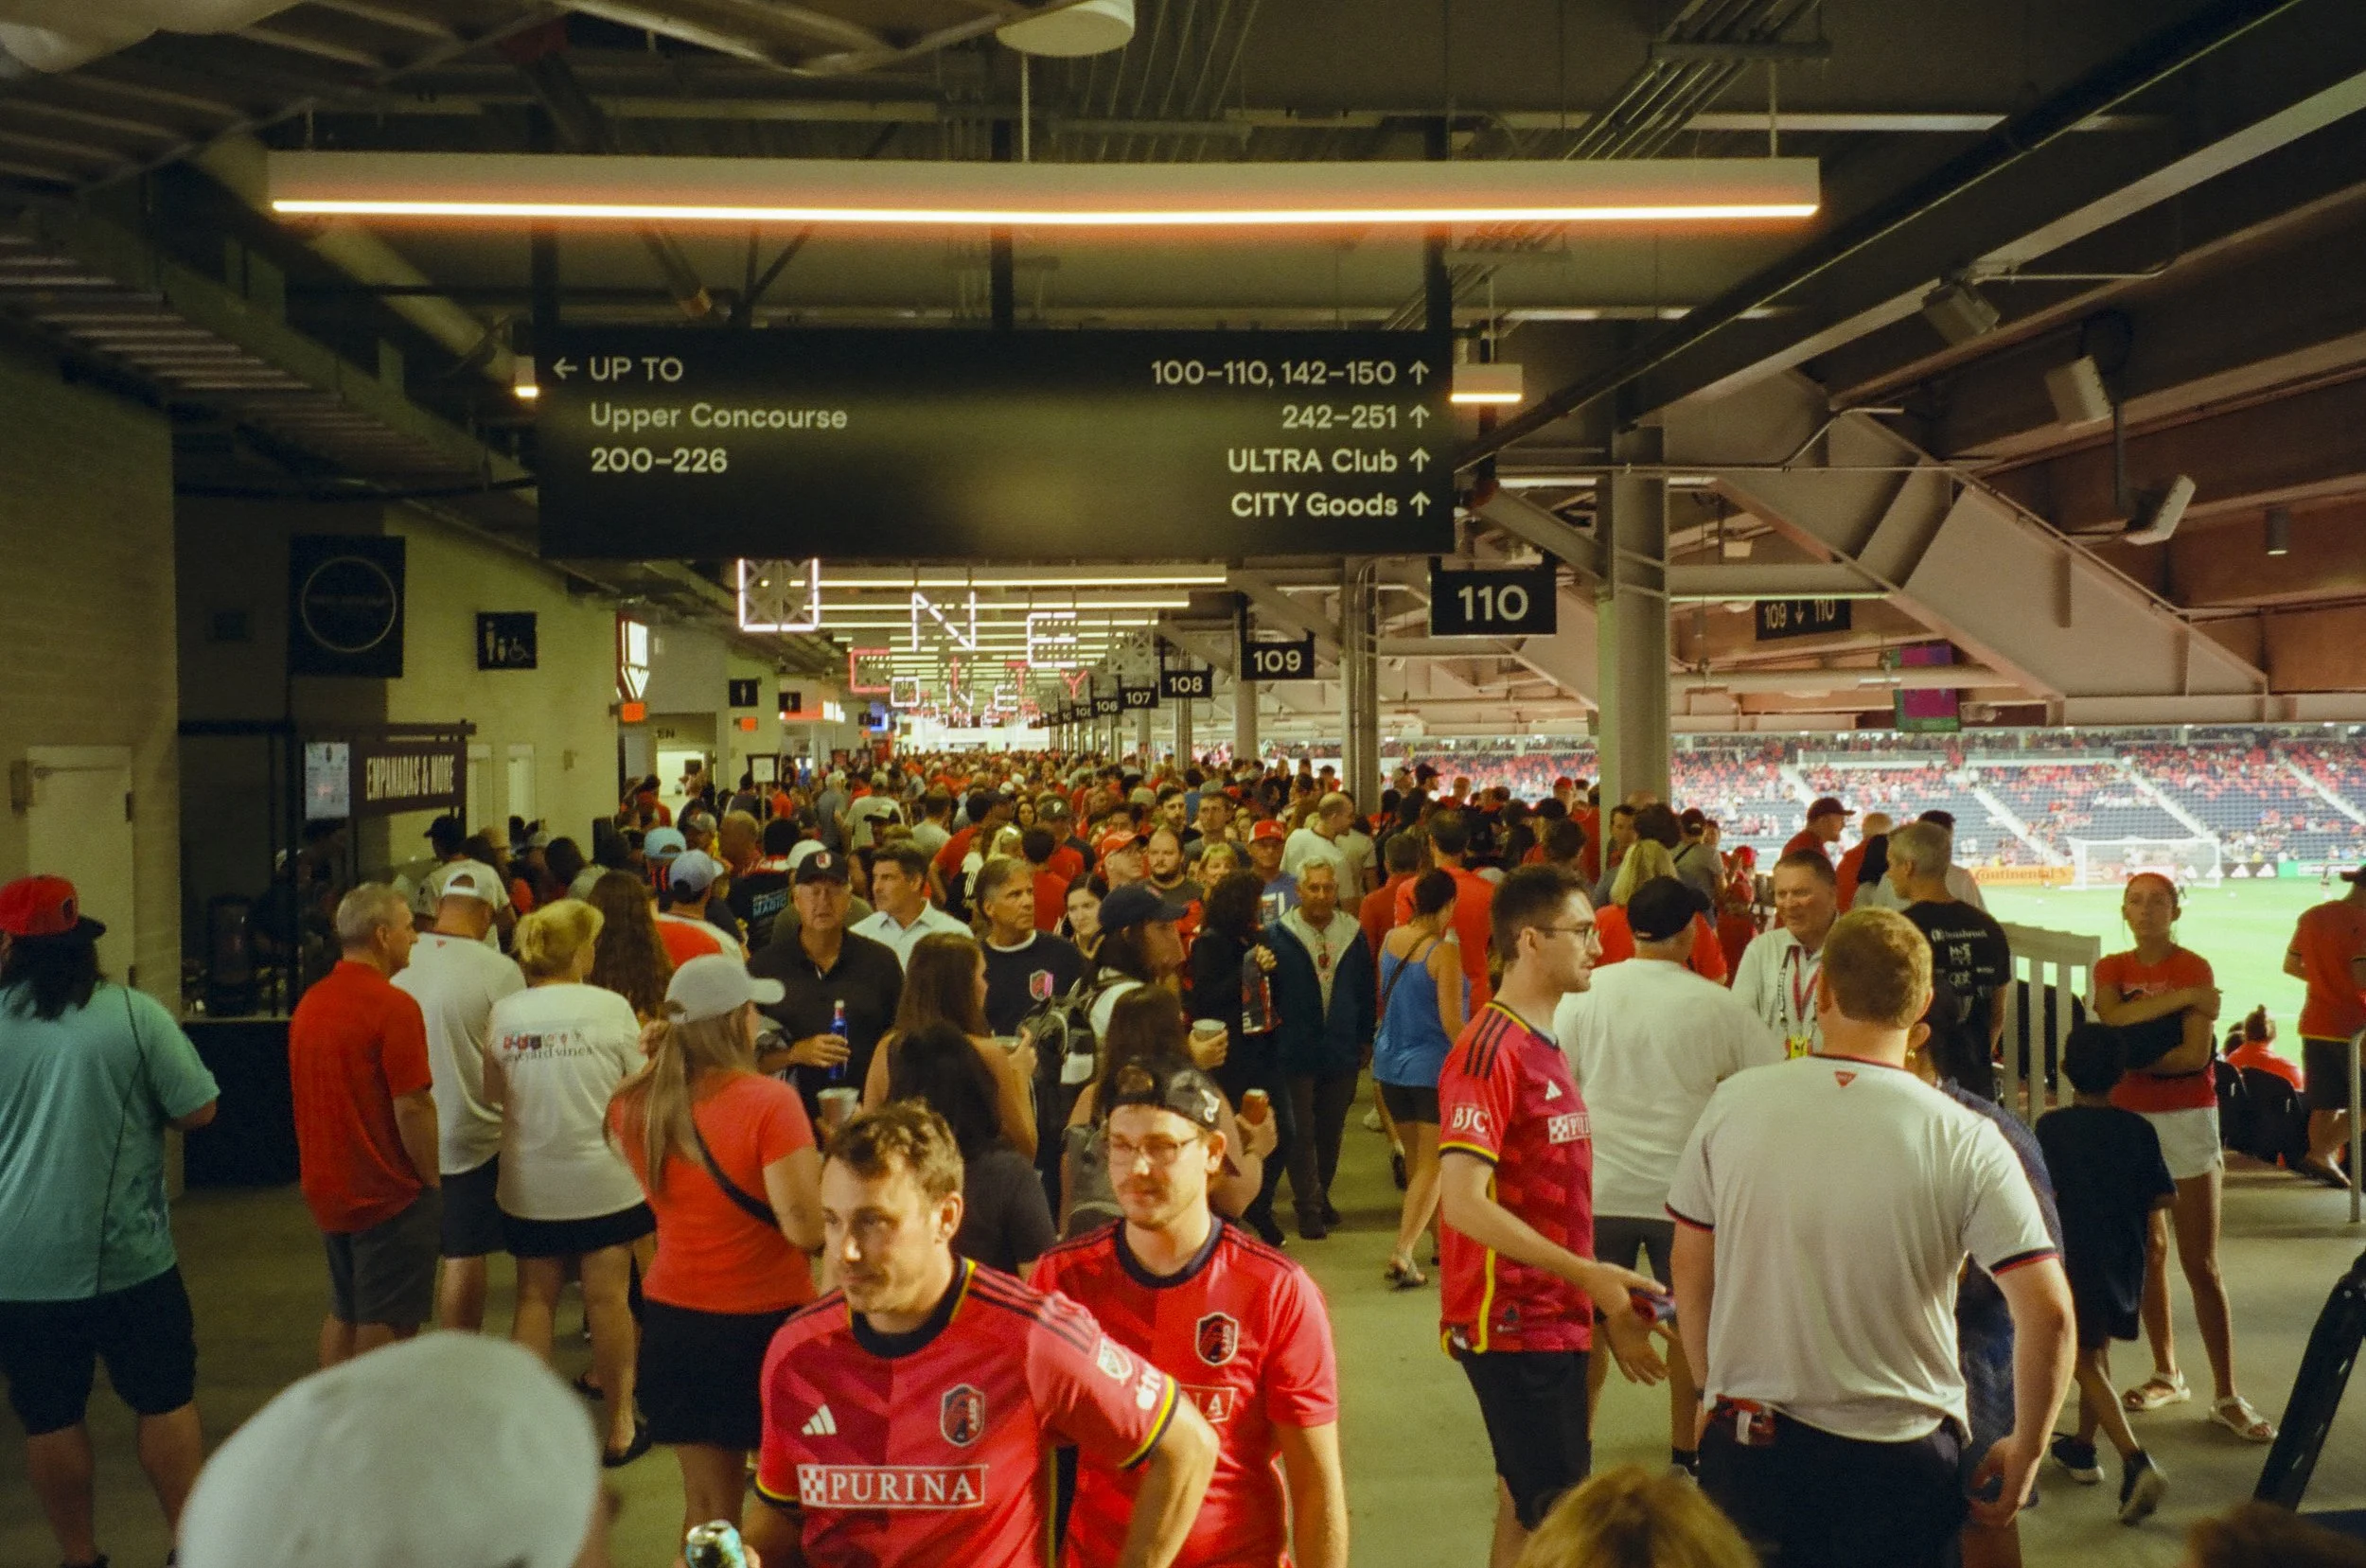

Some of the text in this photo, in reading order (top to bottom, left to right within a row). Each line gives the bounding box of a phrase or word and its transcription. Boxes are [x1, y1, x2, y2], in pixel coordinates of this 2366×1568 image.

[590, 356, 684, 382] UP TO
[1280, 361, 1397, 386] 142-150
[591, 402, 849, 433] Upper Concourse
[1281, 405, 1398, 430] 242-251
[591, 447, 729, 473] 200-226
[1227, 449, 1398, 473] ULTRA Club
[1231, 493, 1398, 518] CITY Goods
[1457, 584, 1530, 621] 110
[1764, 602, 1788, 630] 109
[1252, 649, 1302, 673] 109
[1124, 691, 1152, 706] 107
[1168, 677, 1204, 695] 108
[1452, 1107, 1490, 1134] BJC
[830, 1472, 976, 1503] PURINA
